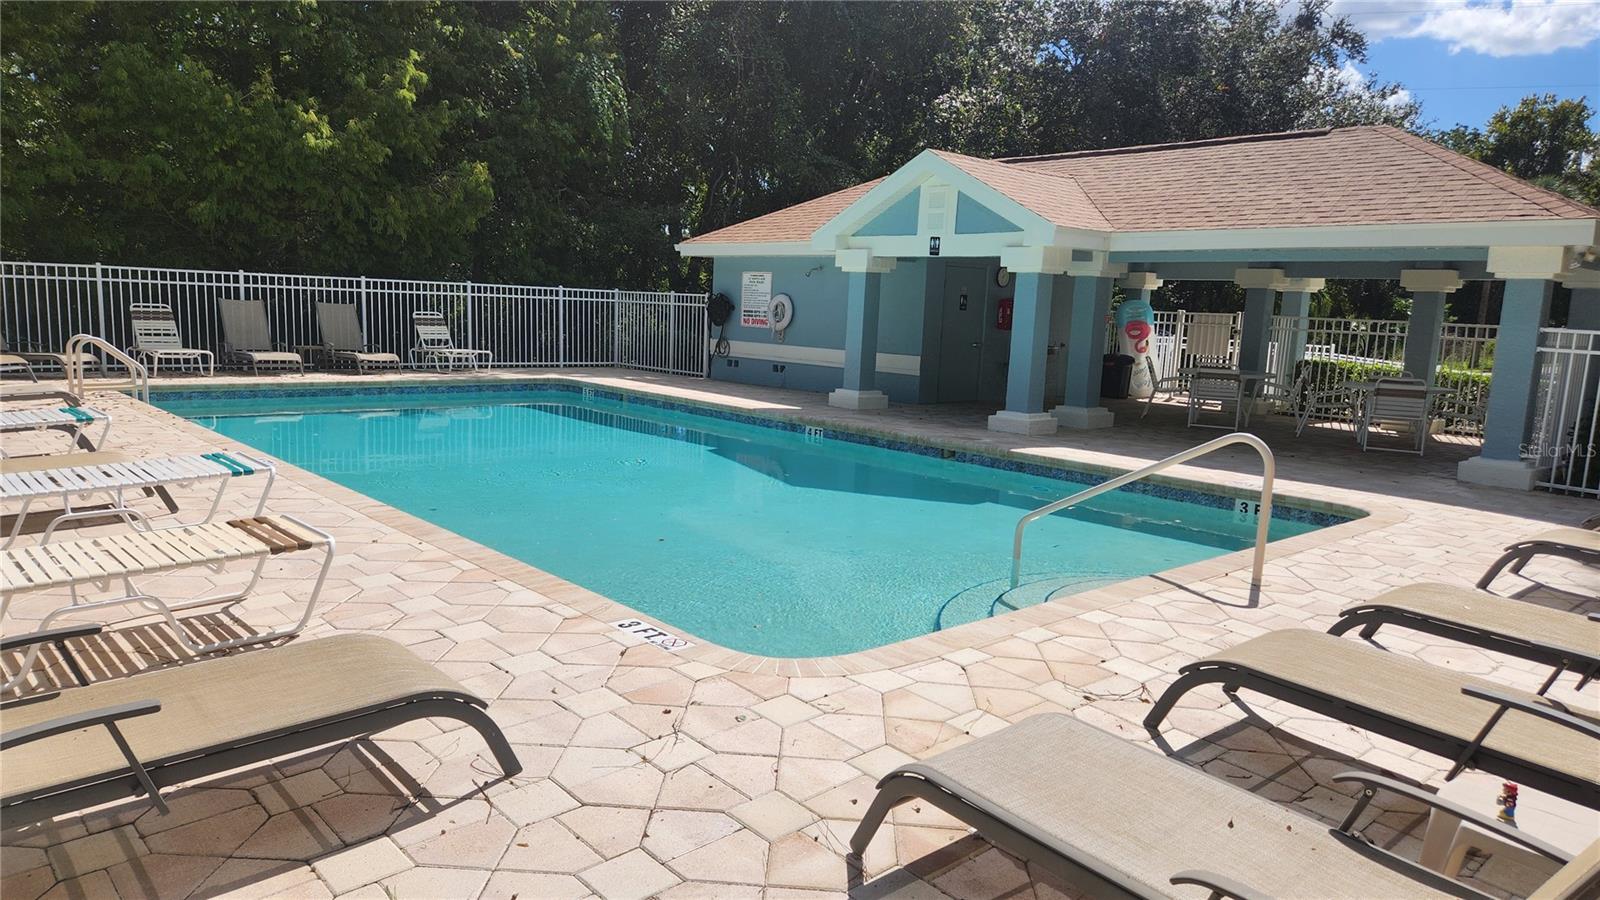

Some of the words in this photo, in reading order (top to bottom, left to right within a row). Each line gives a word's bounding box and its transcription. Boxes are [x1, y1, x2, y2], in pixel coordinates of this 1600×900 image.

[807, 427, 812, 436] 4
[814, 428, 822, 437] FT
[1240, 501, 1249, 513] 3
